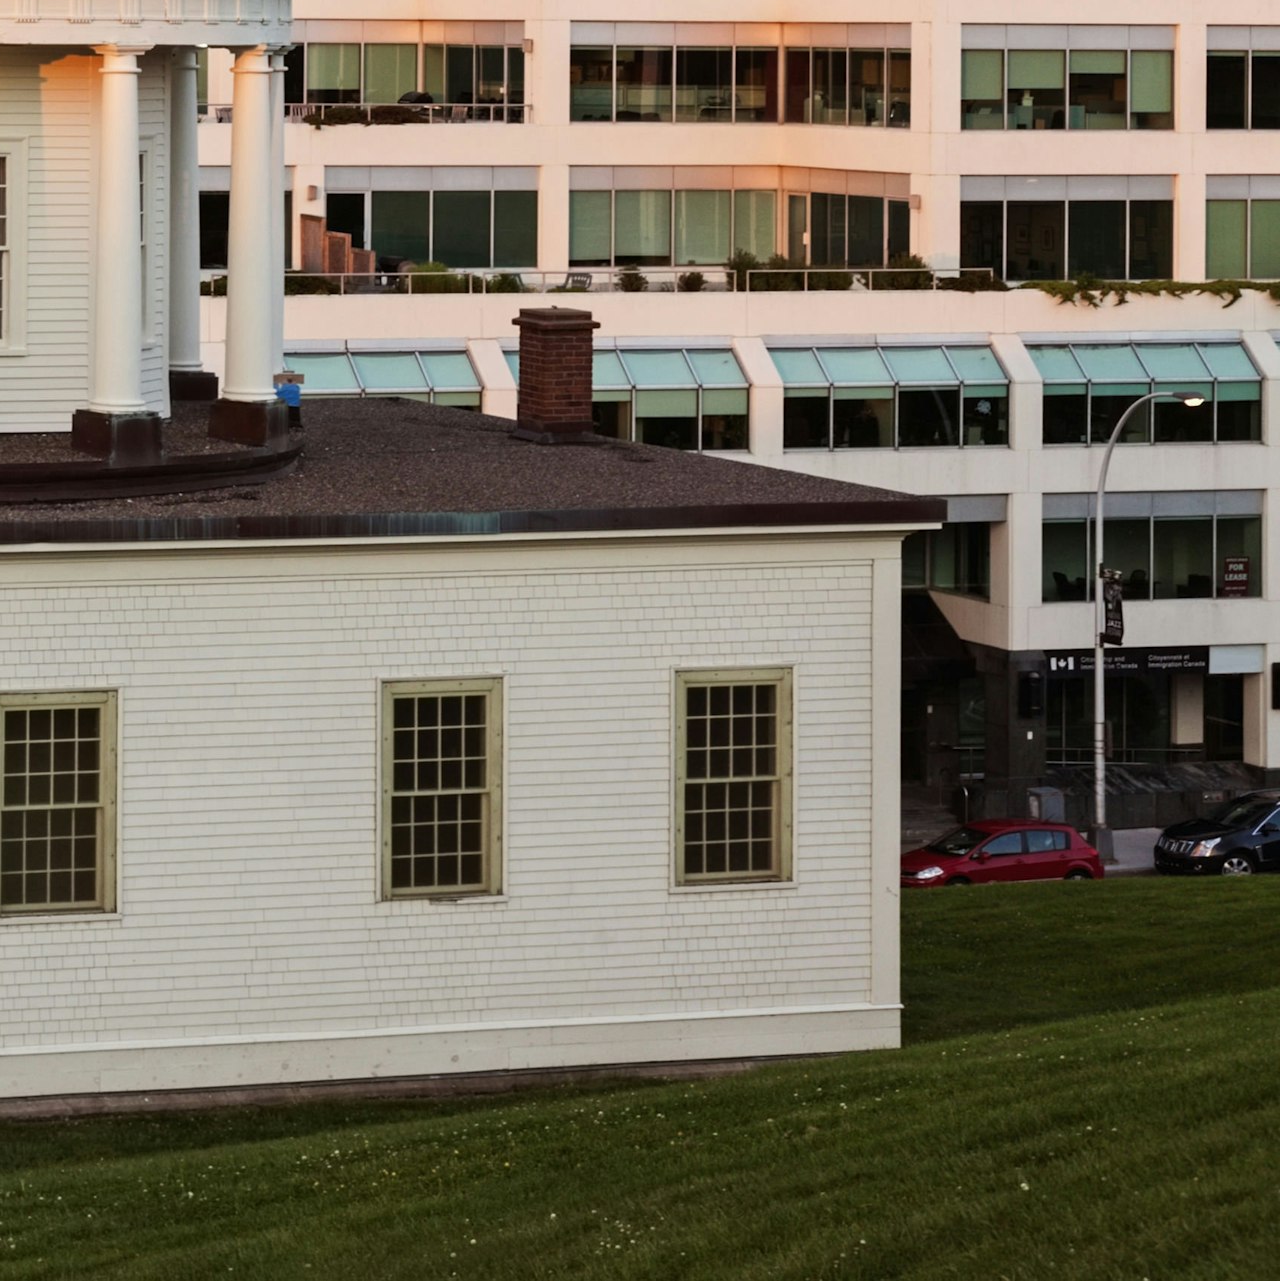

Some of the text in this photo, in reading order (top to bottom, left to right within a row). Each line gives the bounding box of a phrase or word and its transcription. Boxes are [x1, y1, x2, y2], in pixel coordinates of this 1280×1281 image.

[1228, 563, 1244, 571] FOR
[1224, 573, 1248, 581] LEASE
[1107, 619, 1122, 629] JAZZ
[1148, 660, 1206, 669] Immigration Canada
